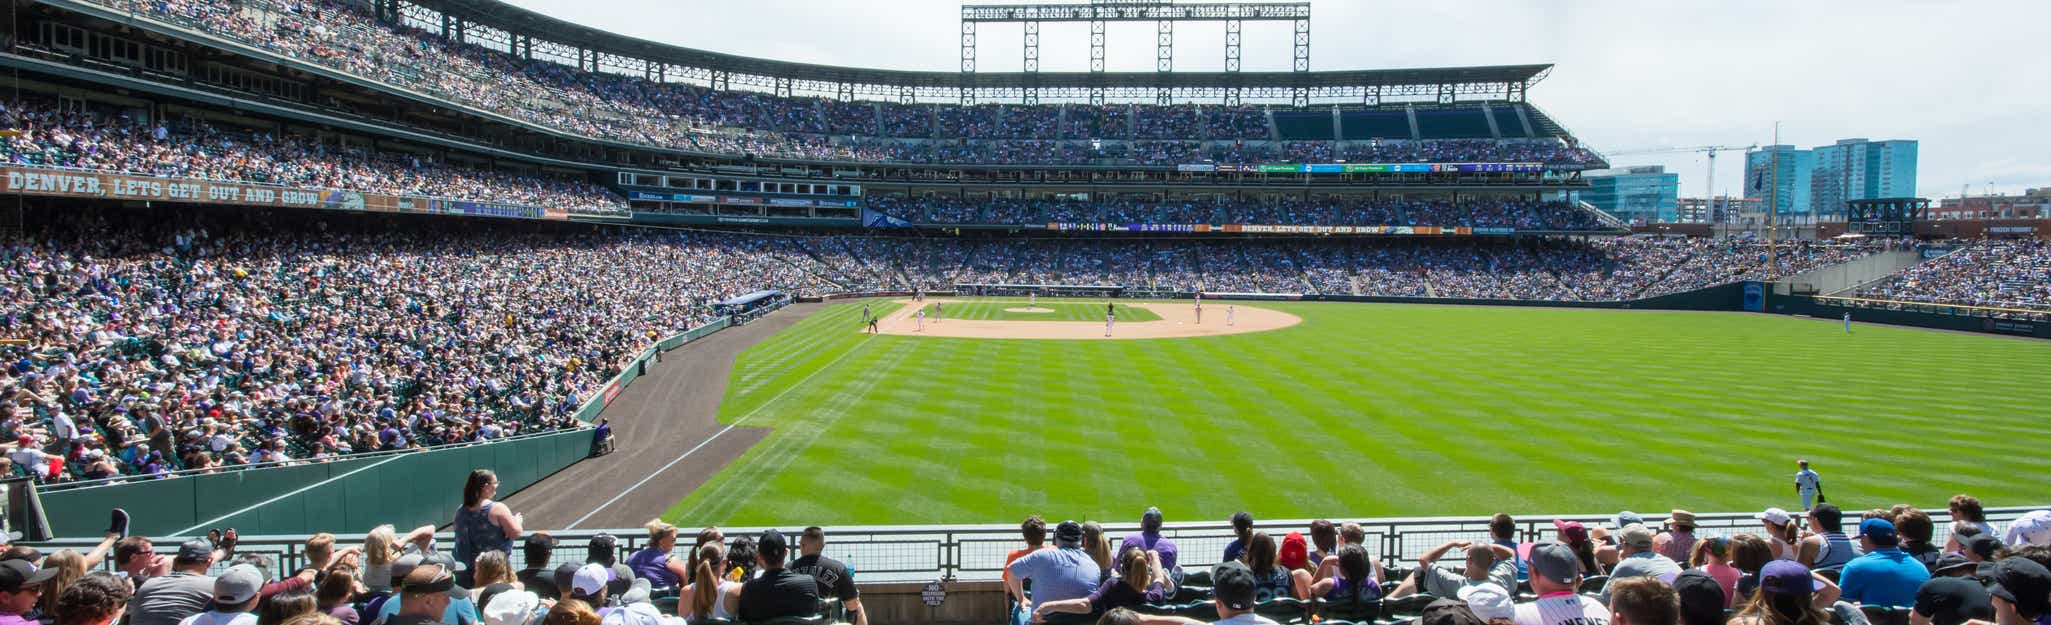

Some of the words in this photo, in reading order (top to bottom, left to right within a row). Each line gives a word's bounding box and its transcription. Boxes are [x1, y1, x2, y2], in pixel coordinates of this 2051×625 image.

[8, 171, 106, 197] DENVER,
[114, 179, 162, 197] LETS
[168, 183, 201, 199] GET
[209, 186, 240, 201] OUT
[246, 188, 275, 203] AND
[282, 191, 318, 205] GROW
